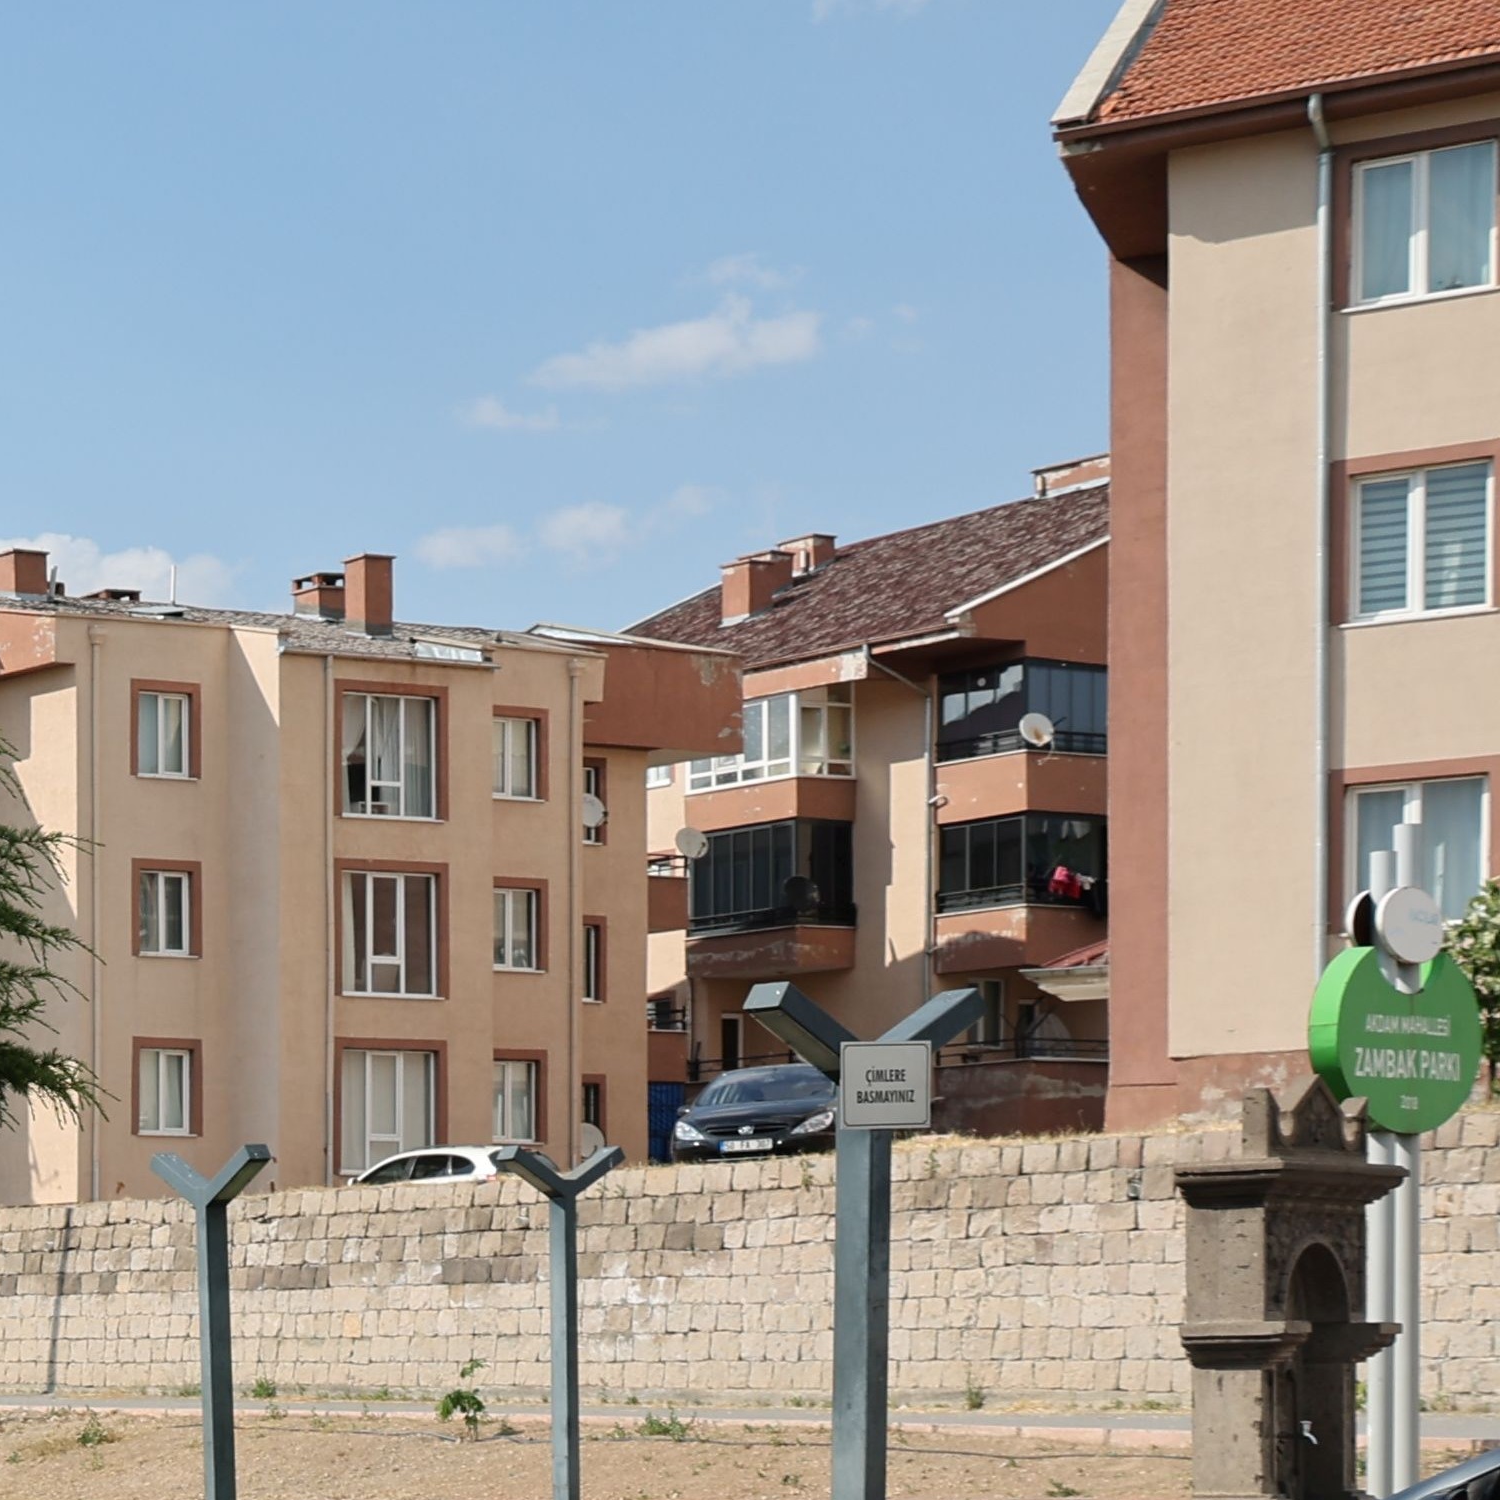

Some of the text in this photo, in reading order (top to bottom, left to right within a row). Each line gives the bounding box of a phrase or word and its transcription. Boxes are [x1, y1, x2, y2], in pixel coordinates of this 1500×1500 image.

[1354, 1047, 1461, 1082] ZAMBAK PARKI
[865, 1066, 906, 1087] ÇİMLERE
[856, 1089, 915, 1104] BASMAYINIZ
